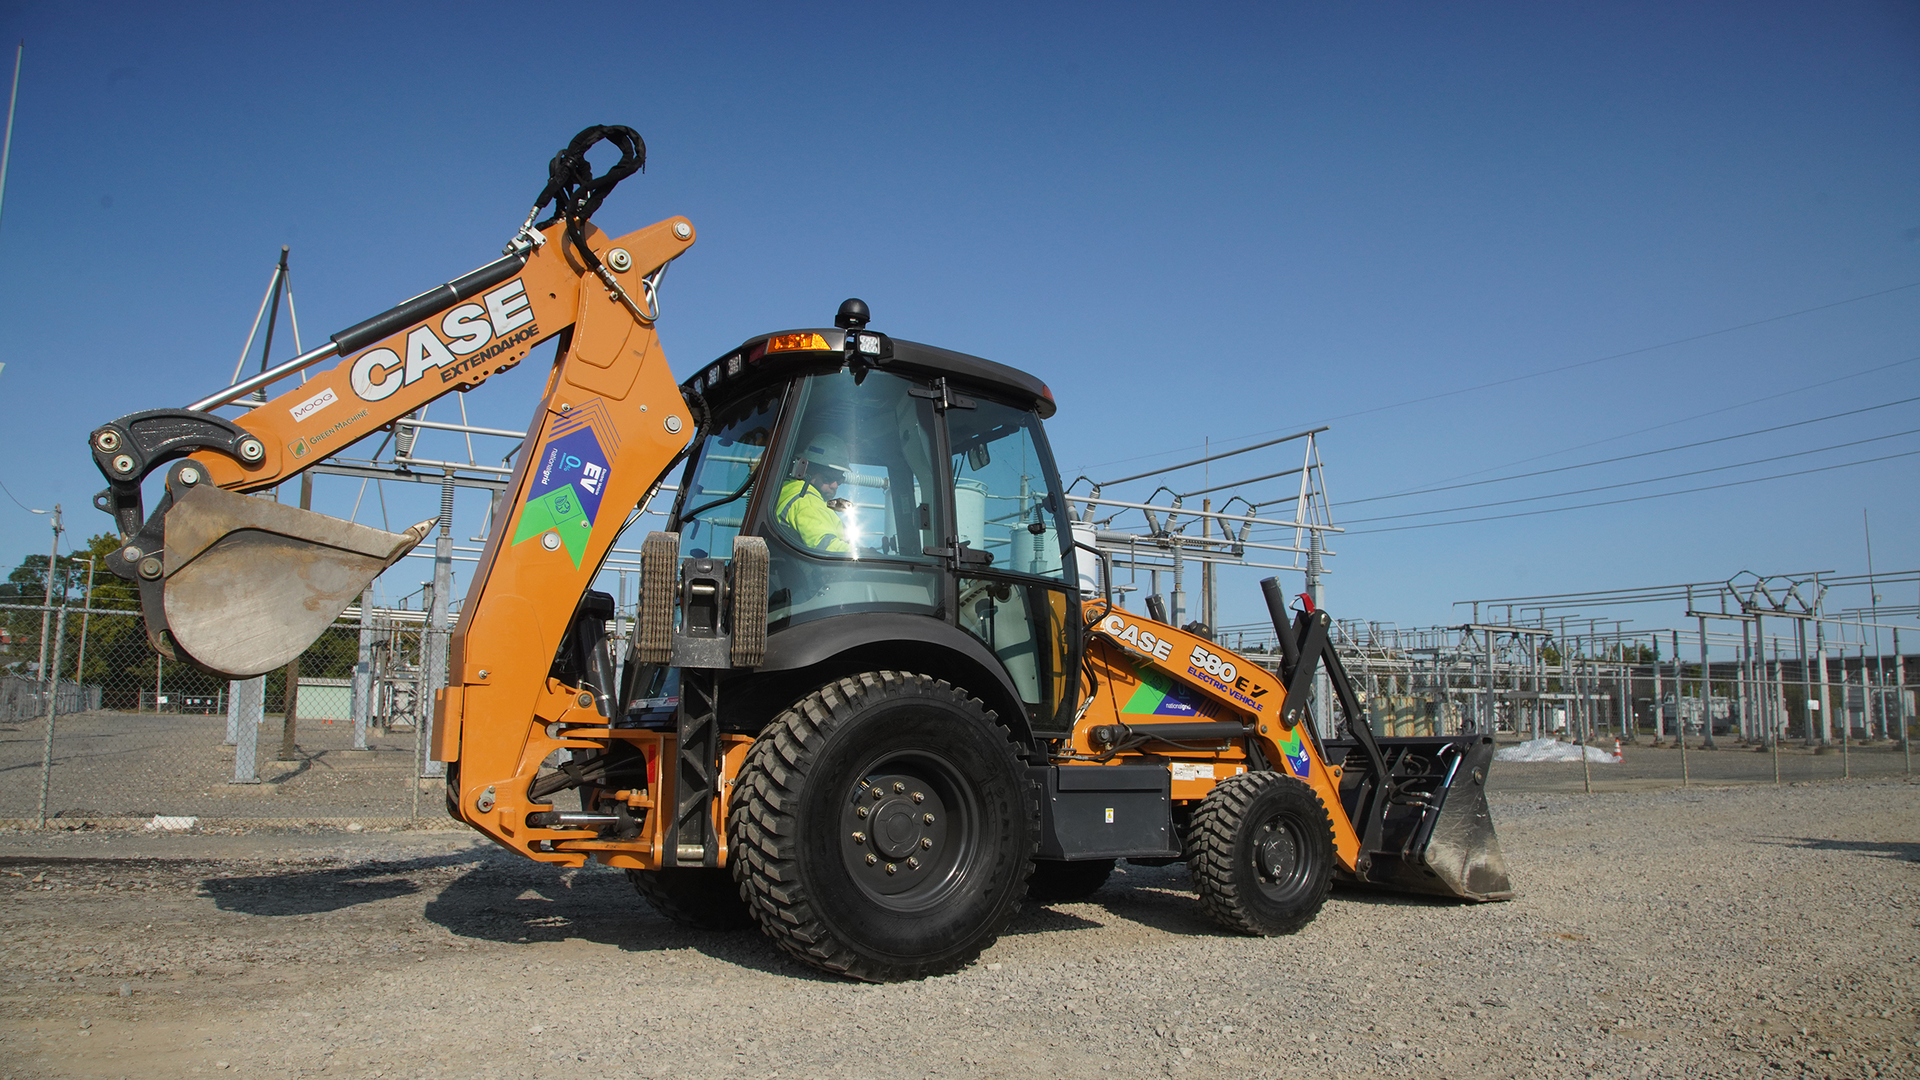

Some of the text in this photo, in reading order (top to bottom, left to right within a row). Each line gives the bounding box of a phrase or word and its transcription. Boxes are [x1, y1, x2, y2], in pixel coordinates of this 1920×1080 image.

[350, 277, 535, 402] CASE
[440, 324, 540, 383] EXTENDAHOE
[294, 393, 333, 418] MOOG
[580, 462, 602, 494] EV
[1105, 614, 1174, 662] CASE
[1187, 666, 1263, 712] ELECTRIC VEHICLE
